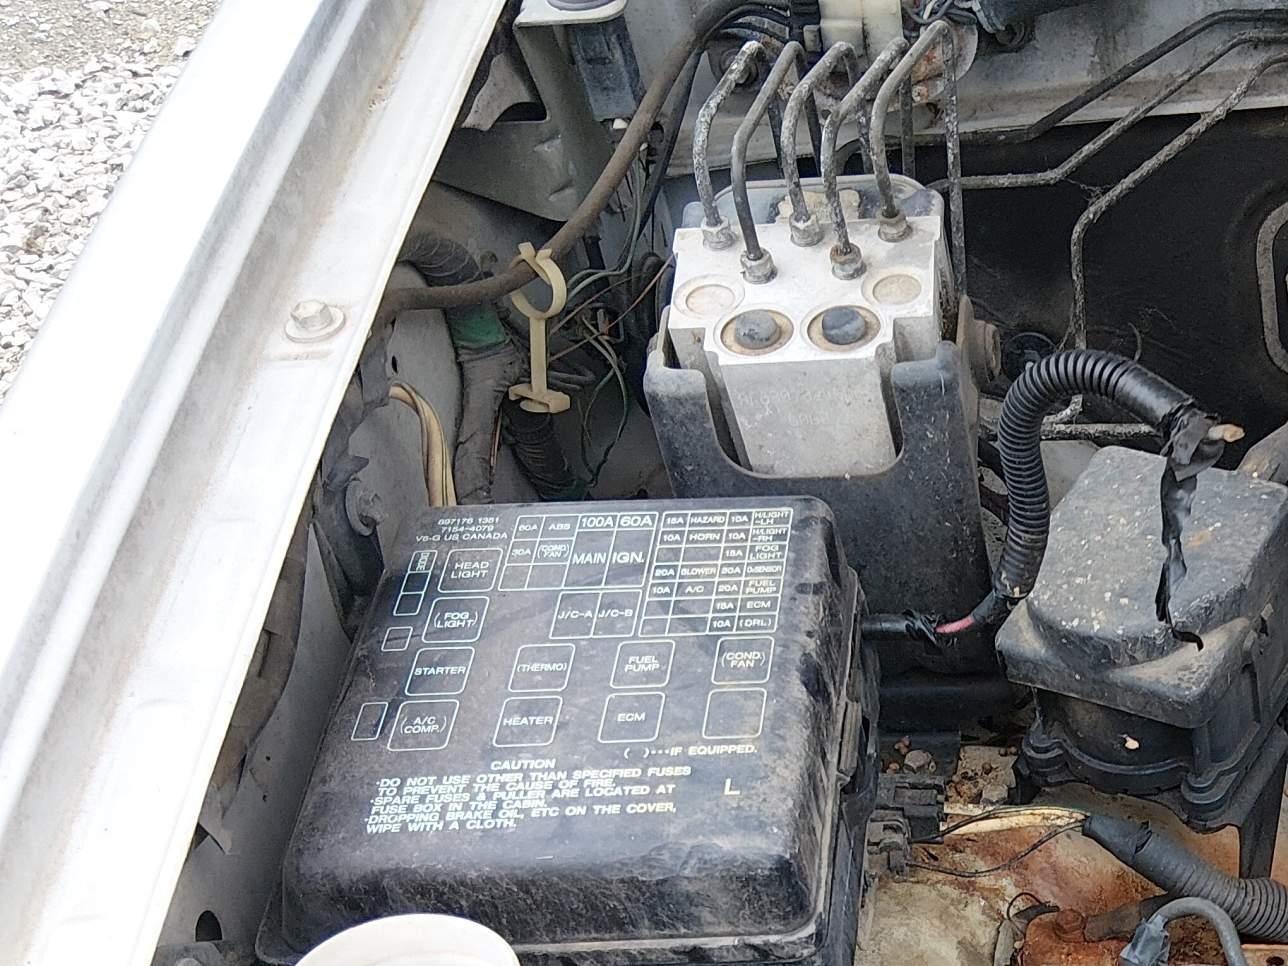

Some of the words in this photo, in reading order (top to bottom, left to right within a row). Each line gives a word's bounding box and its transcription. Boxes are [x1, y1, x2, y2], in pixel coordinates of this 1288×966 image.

[580, 516, 614, 528] 100A
[619, 515, 653, 527] 60A
[690, 515, 726, 524] HAZARD
[754, 511, 790, 519] H/LIGHT
[548, 523, 571, 531] ABS
[444, 533, 459, 542] US
[462, 531, 508, 541] CANADA
[663, 534, 682, 542] 10A
[689, 532, 721, 541] HORN
[728, 532, 746, 540] 10A
[754, 544, 780, 552] FOG
[572, 552, 607, 564] MAIN
[612, 551, 645, 563] IGN.
[749, 551, 783, 560] LIGHT
[454, 561, 490, 570] HEAD
[450, 569, 489, 579] LIGHT
[681, 567, 717, 576] BLOWER
[748, 579, 776, 587] FUEL
[652, 586, 671, 594] 10A
[685, 585, 705, 593] A/C
[745, 586, 777, 594] PUMP
[746, 600, 771, 609] ECM
[557, 610, 593, 620] J/C-A
[598, 608, 634, 618] J/C-B
[712, 620, 731, 628] 10A
[628, 654, 658, 664] FUEL
[730, 660, 755, 668] FAN
[414, 665, 467, 676] STARTER
[516, 662, 567, 673] (THERMO)
[624, 662, 660, 673] PUMP
[503, 715, 553, 726] HEATER
[616, 711, 646, 722] ECM
[688, 744, 758, 756] EQUIPPED.
[490, 758, 556, 770] CAUTION
[406, 776, 437, 786] NOT
[443, 775, 471, 785] USE
[476, 773, 524, 783] OTHER
[529, 771, 568, 781] THAN
[572, 768, 642, 779] SPECIFIED
[648, 766, 692, 776] FUSES
[378, 787, 397, 797] TO
[403, 785, 466, 795] PREVENT
[472, 783, 501, 793] THE
[506, 781, 557, 791] CAUSE
[559, 780, 578, 789] OF
[583, 778, 616, 788] FIRE.
[723, 778, 741, 796] L
[425, 793, 471, 803] FUSES
[493, 789, 545, 801] PULLER
[551, 787, 579, 798] ARE
[585, 785, 651, 797] LOCATED
[656, 784, 676, 794] AT
[371, 804, 408, 815] FUSE
[413, 803, 443, 813] BOX
[448, 802, 463, 811] IN
[469, 801, 498, 811] THE
[502, 799, 548, 810] CABIN.
[445, 810, 493, 821] BRAKE
[498, 808, 525, 819] OIL,
[531, 806, 560, 817] ETC
[565, 805, 587, 815] ON
[593, 804, 621, 815] THE
[626, 802, 677, 814] COVER,
[366, 822, 402, 834] WIPE
[407, 821, 444, 832] WITH
[449, 820, 460, 830] A
[466, 818, 517, 830] CLOTH.
